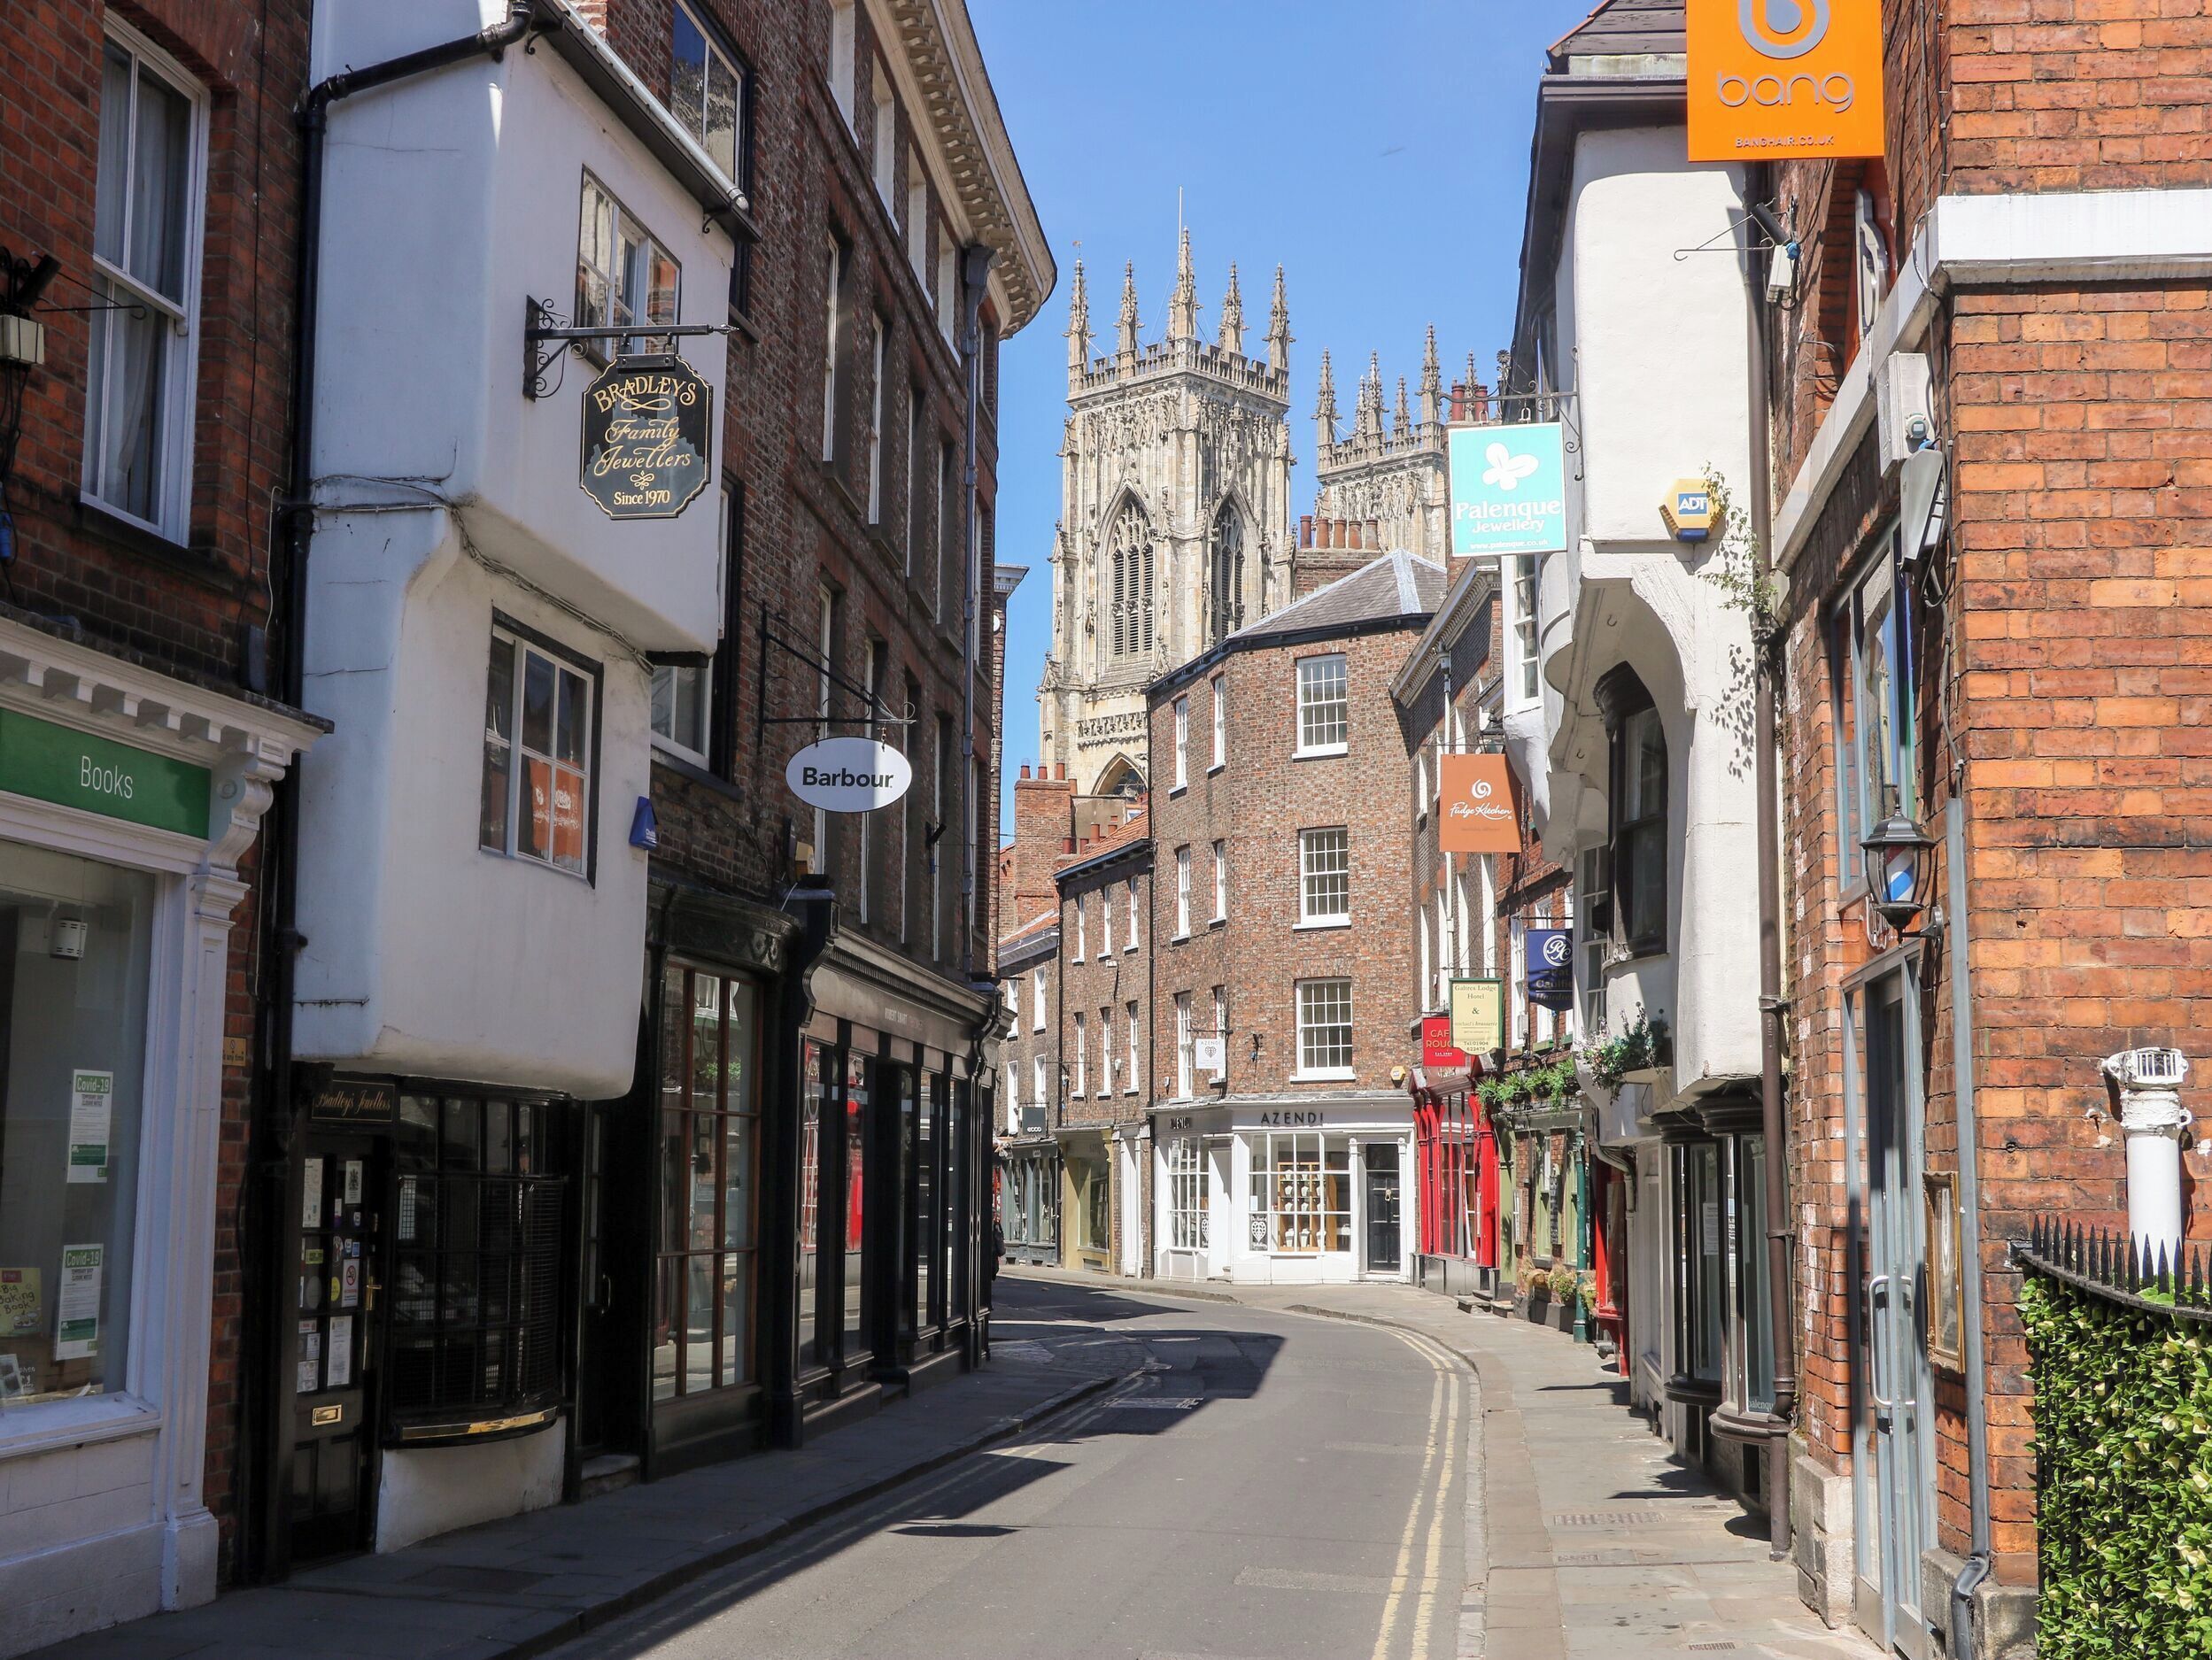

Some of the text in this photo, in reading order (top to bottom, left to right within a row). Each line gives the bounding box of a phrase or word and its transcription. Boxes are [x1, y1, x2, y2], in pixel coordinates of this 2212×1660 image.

[1717, 72, 1854, 113] bang
[1736, 135, 1834, 148] BANGHAIR.CO.UK
[605, 416, 680, 447] Family
[593, 444, 691, 476] Jewellers
[614, 490, 670, 507] Since 1970
[1679, 496, 1707, 512] ADT
[1456, 498, 1563, 525] Palenque
[1472, 518, 1545, 535] Jewellery
[1469, 538, 1549, 551] www.palenque.co.uk
[81, 755, 133, 799] Books
[802, 767, 893, 788] Barbour
[1450, 801, 1513, 821] Fudge Kitchen
[1426, 1039, 1450, 1048] ROU
[77, 1077, 110, 1092] Covid-19
[1261, 1112, 1324, 1124] AZENDI
[67, 1251, 99, 1266] Covid-19
[4, 1302, 30, 1315] Book
